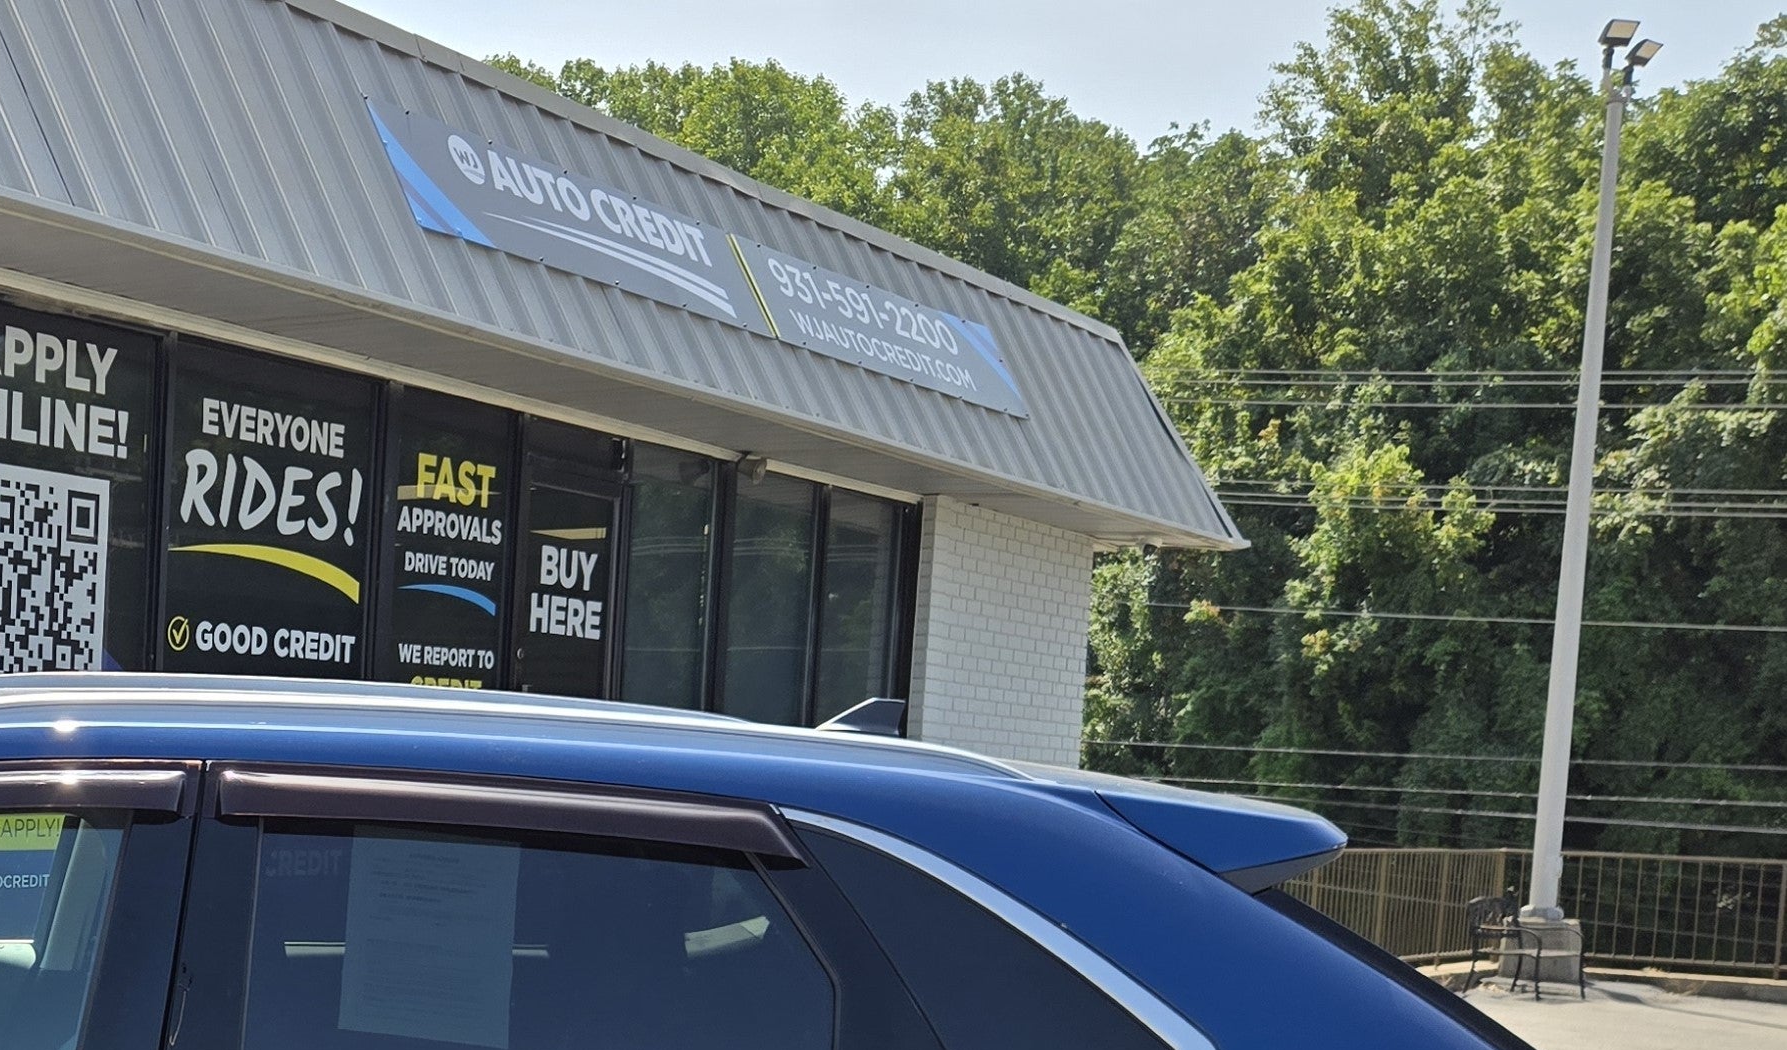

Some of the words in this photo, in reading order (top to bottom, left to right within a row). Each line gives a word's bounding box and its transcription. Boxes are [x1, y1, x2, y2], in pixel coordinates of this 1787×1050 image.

[487, 149, 591, 222] AUTO
[590, 188, 713, 268] CREDIT
[767, 257, 959, 356] 931-591-2200
[789, 308, 978, 391] WJAUTOCREDIT.COM
[202, 397, 345, 459] EVERYONE
[180, 448, 363, 547] RIDES!
[416, 452, 497, 509] FAST
[397, 505, 503, 546] APPROVALS
[404, 551, 447, 577] DRIVE
[449, 556, 495, 582] TODAY
[540, 544, 599, 592] BUY
[529, 592, 603, 641] HERE
[195, 620, 268, 656] GOOD
[273, 627, 356, 664] CREDIT
[398, 643, 422, 664] WE
[423, 646, 475, 668] REPORT
[477, 650, 495, 670] TO
[0, 817, 61, 838] APPLY!
